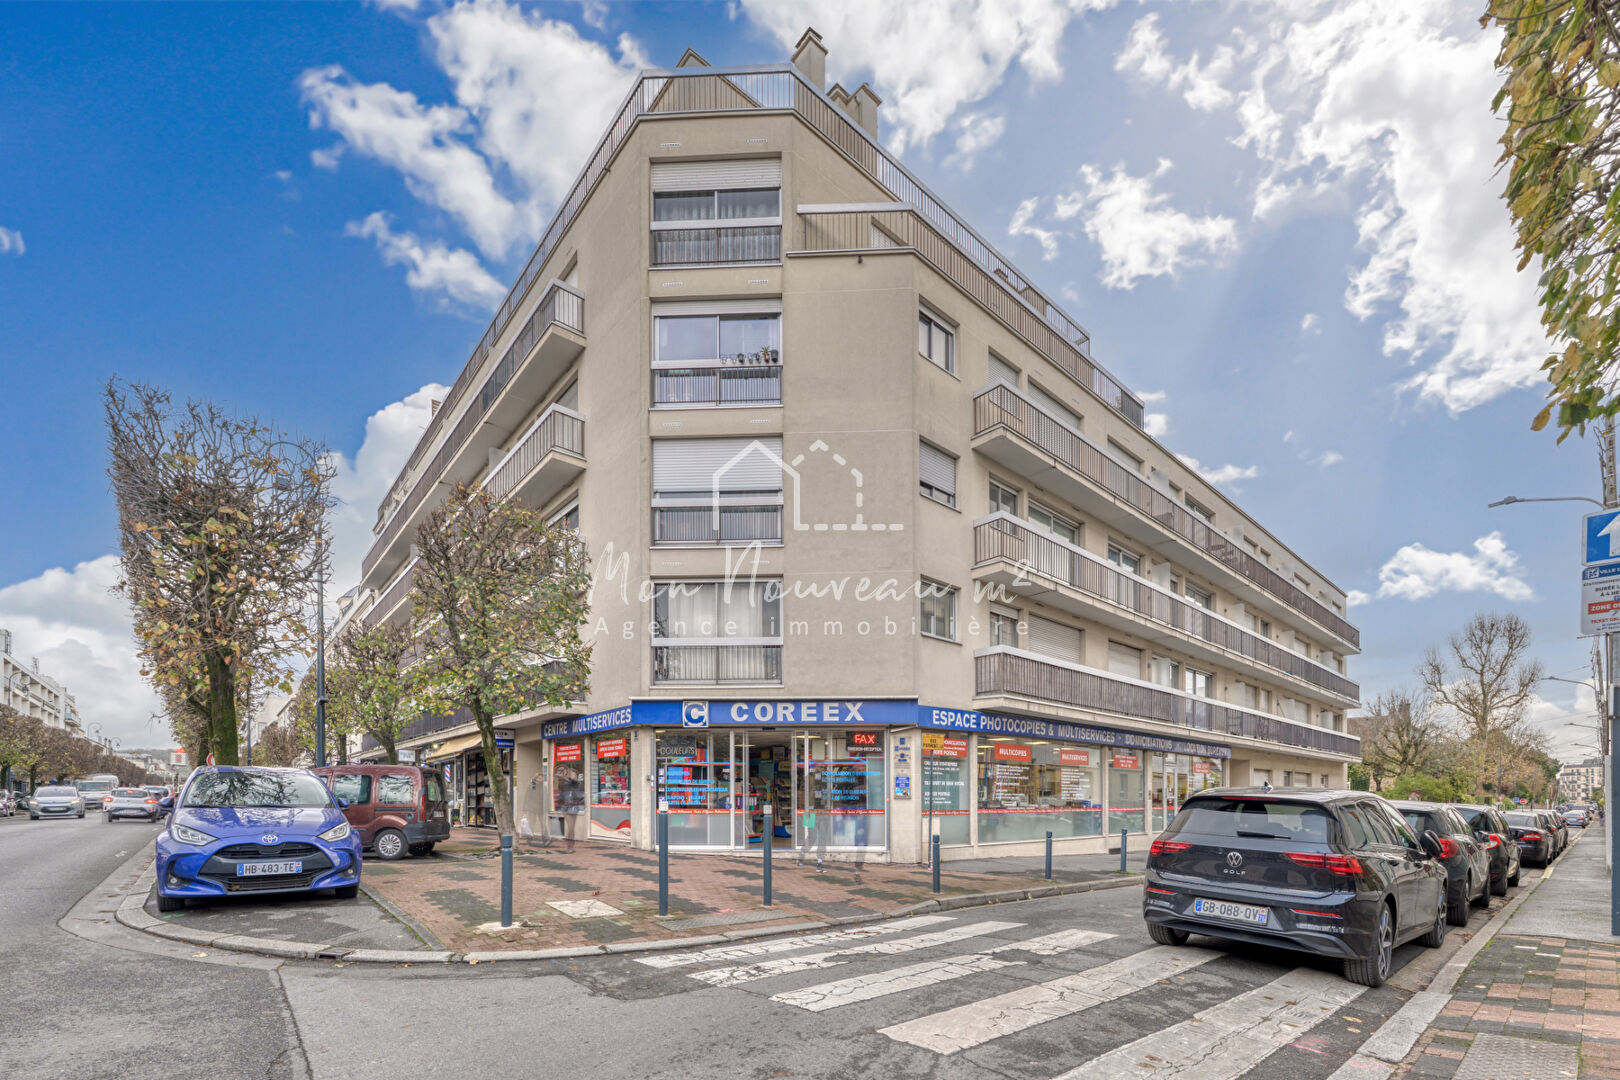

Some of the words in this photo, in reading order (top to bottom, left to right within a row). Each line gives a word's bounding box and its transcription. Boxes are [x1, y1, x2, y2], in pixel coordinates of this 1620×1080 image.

[1591, 603, 1611, 611] ZONE
[730, 702, 864, 722] COREEX
[544, 722, 568, 737] CENTRE
[572, 708, 631, 733] MULTISERVICES
[932, 709, 977, 728] ESPACE
[980, 715, 1046, 736] PHOTOCOPIES
[1058, 726, 1115, 743] MULTISERVICES
[854, 734, 875, 744] FAX
[999, 747, 1027, 757] MULTICOPIES
[245, 862, 295, 875] HB-483-TE
